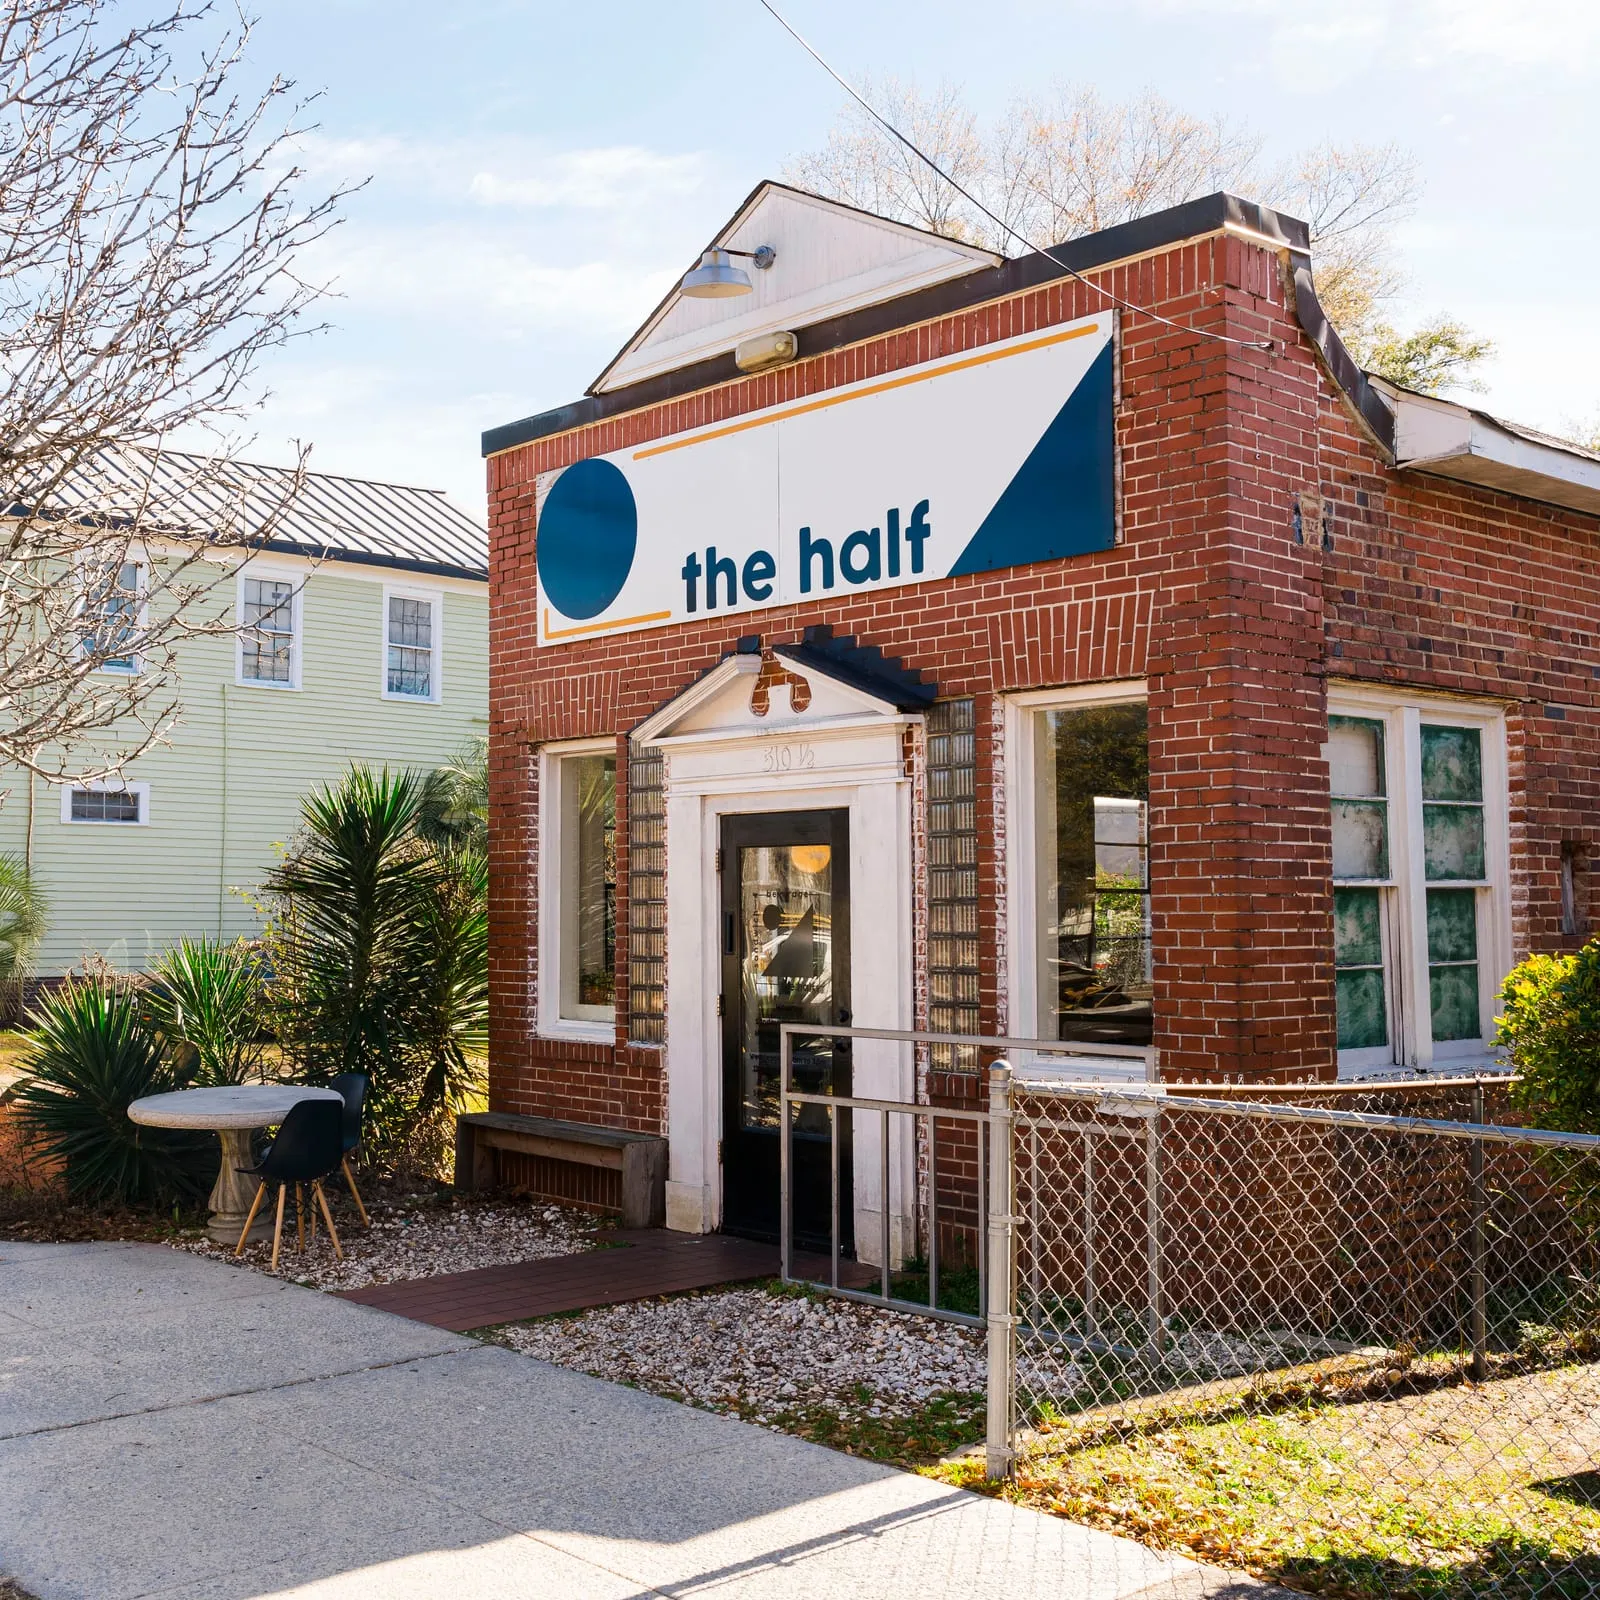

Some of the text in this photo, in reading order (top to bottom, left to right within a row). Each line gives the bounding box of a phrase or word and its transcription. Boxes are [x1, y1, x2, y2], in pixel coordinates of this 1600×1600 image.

[682, 499, 931, 613] the half
[763, 745, 791, 772] 310
[766, 889, 808, 899] berage
